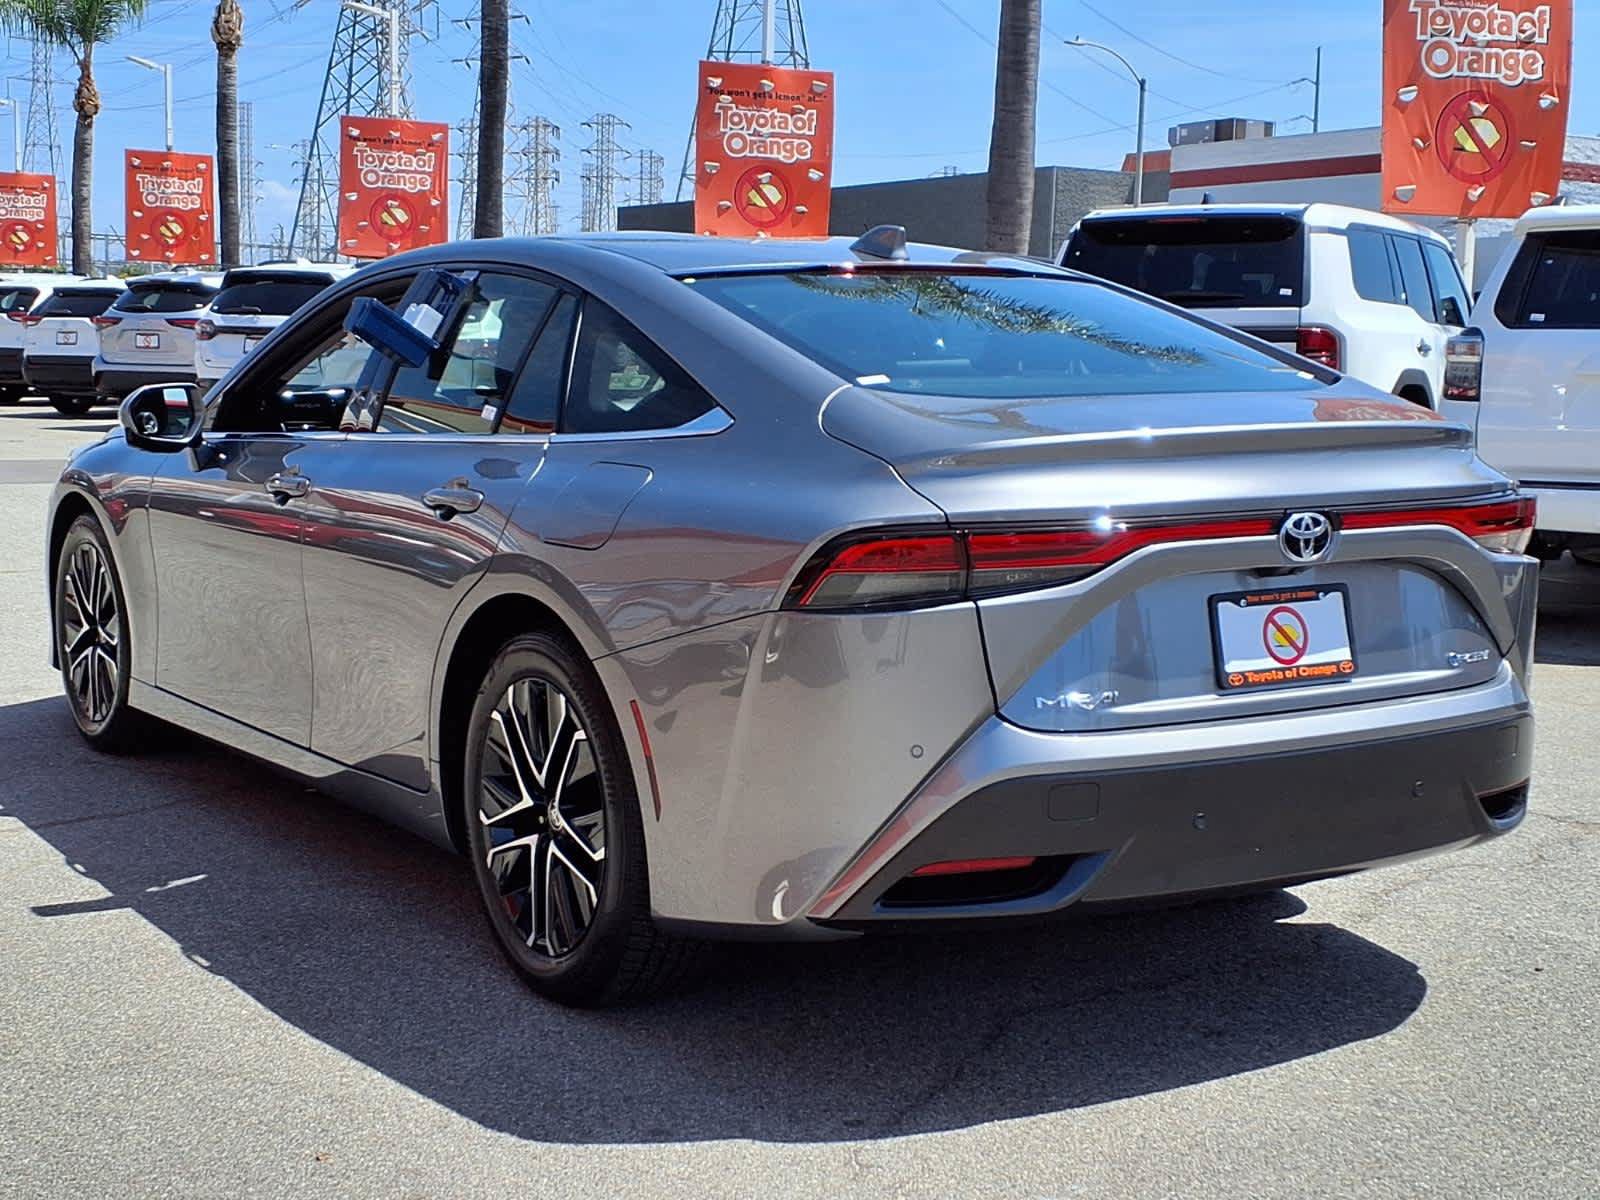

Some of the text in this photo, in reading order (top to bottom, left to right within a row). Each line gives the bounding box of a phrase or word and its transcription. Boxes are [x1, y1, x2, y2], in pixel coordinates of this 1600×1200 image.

[1409, 0, 1551, 43] Toyota of
[1422, 38, 1544, 86] Orange
[715, 103, 817, 135] Toyota of
[724, 131, 812, 163] Orange
[353, 148, 435, 171] Toyota of
[361, 168, 431, 192] Orange
[0, 193, 47, 208] oyota of
[143, 192, 201, 210] Orange
[0, 207, 45, 221] Orange
[1245, 664, 1337, 682] Toyota of Orange
